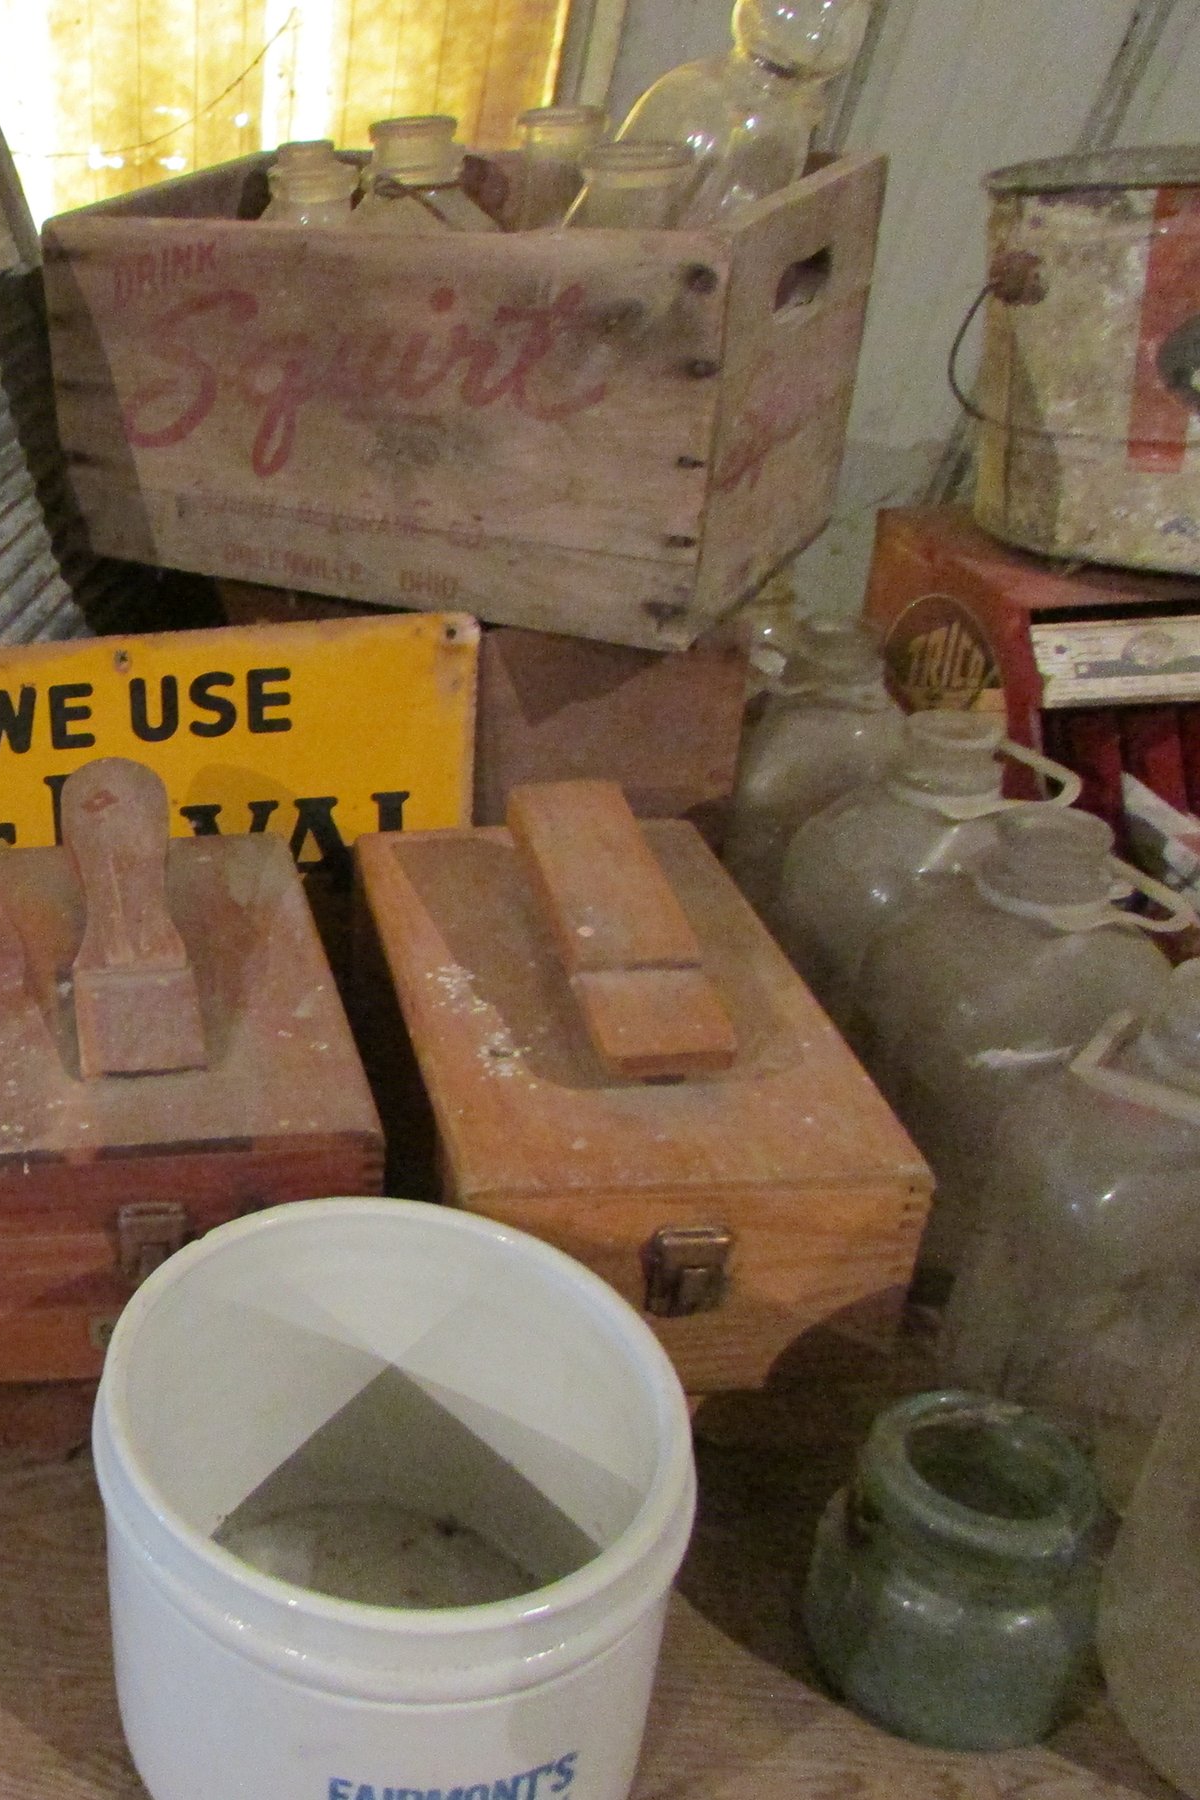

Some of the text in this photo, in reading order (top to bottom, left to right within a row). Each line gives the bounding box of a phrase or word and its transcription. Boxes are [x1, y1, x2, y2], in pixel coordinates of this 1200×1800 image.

[122, 284, 607, 476] Squirt
[128, 667, 293, 743] USE
[328, 1751, 578, 1800] FNT'S
